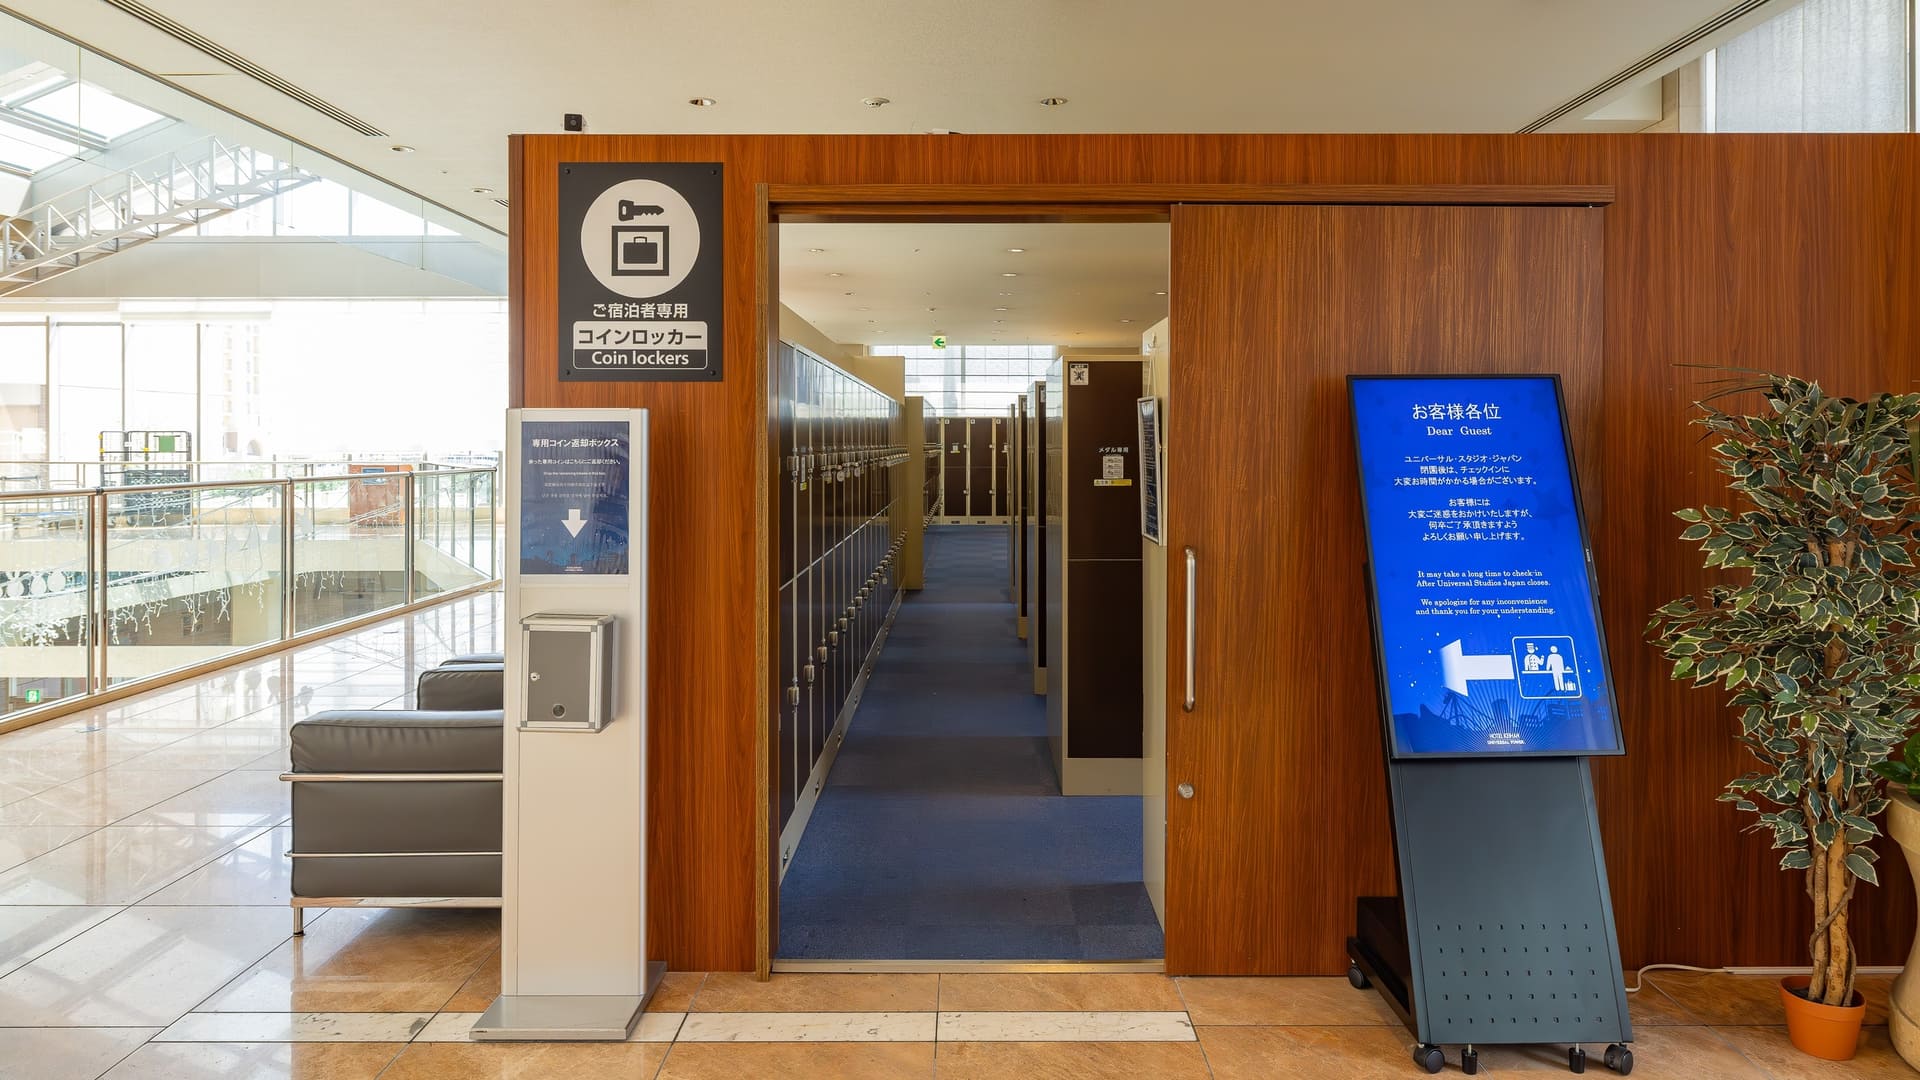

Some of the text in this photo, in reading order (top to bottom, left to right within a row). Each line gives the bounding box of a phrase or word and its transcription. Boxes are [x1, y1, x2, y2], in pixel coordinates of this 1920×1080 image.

[593, 303, 688, 319] ご宿泊者専用
[579, 329, 702, 345] コインロッカー
[592, 350, 689, 365] Coin lockers
[1412, 402, 1502, 420] お客様各位
[1427, 426, 1493, 436] Dear Guest
[532, 438, 619, 448] 専用コイン返却ボックス
[1448, 498, 1491, 507] お客様には
[1468, 570, 1483, 579] long
[1512, 569, 1543, 577] check-in
[1503, 579, 1526, 587] Japan
[1434, 598, 1468, 607] apologize
[1497, 597, 1547, 605] inconvenience
[1500, 606, 1556, 615] understanding.
